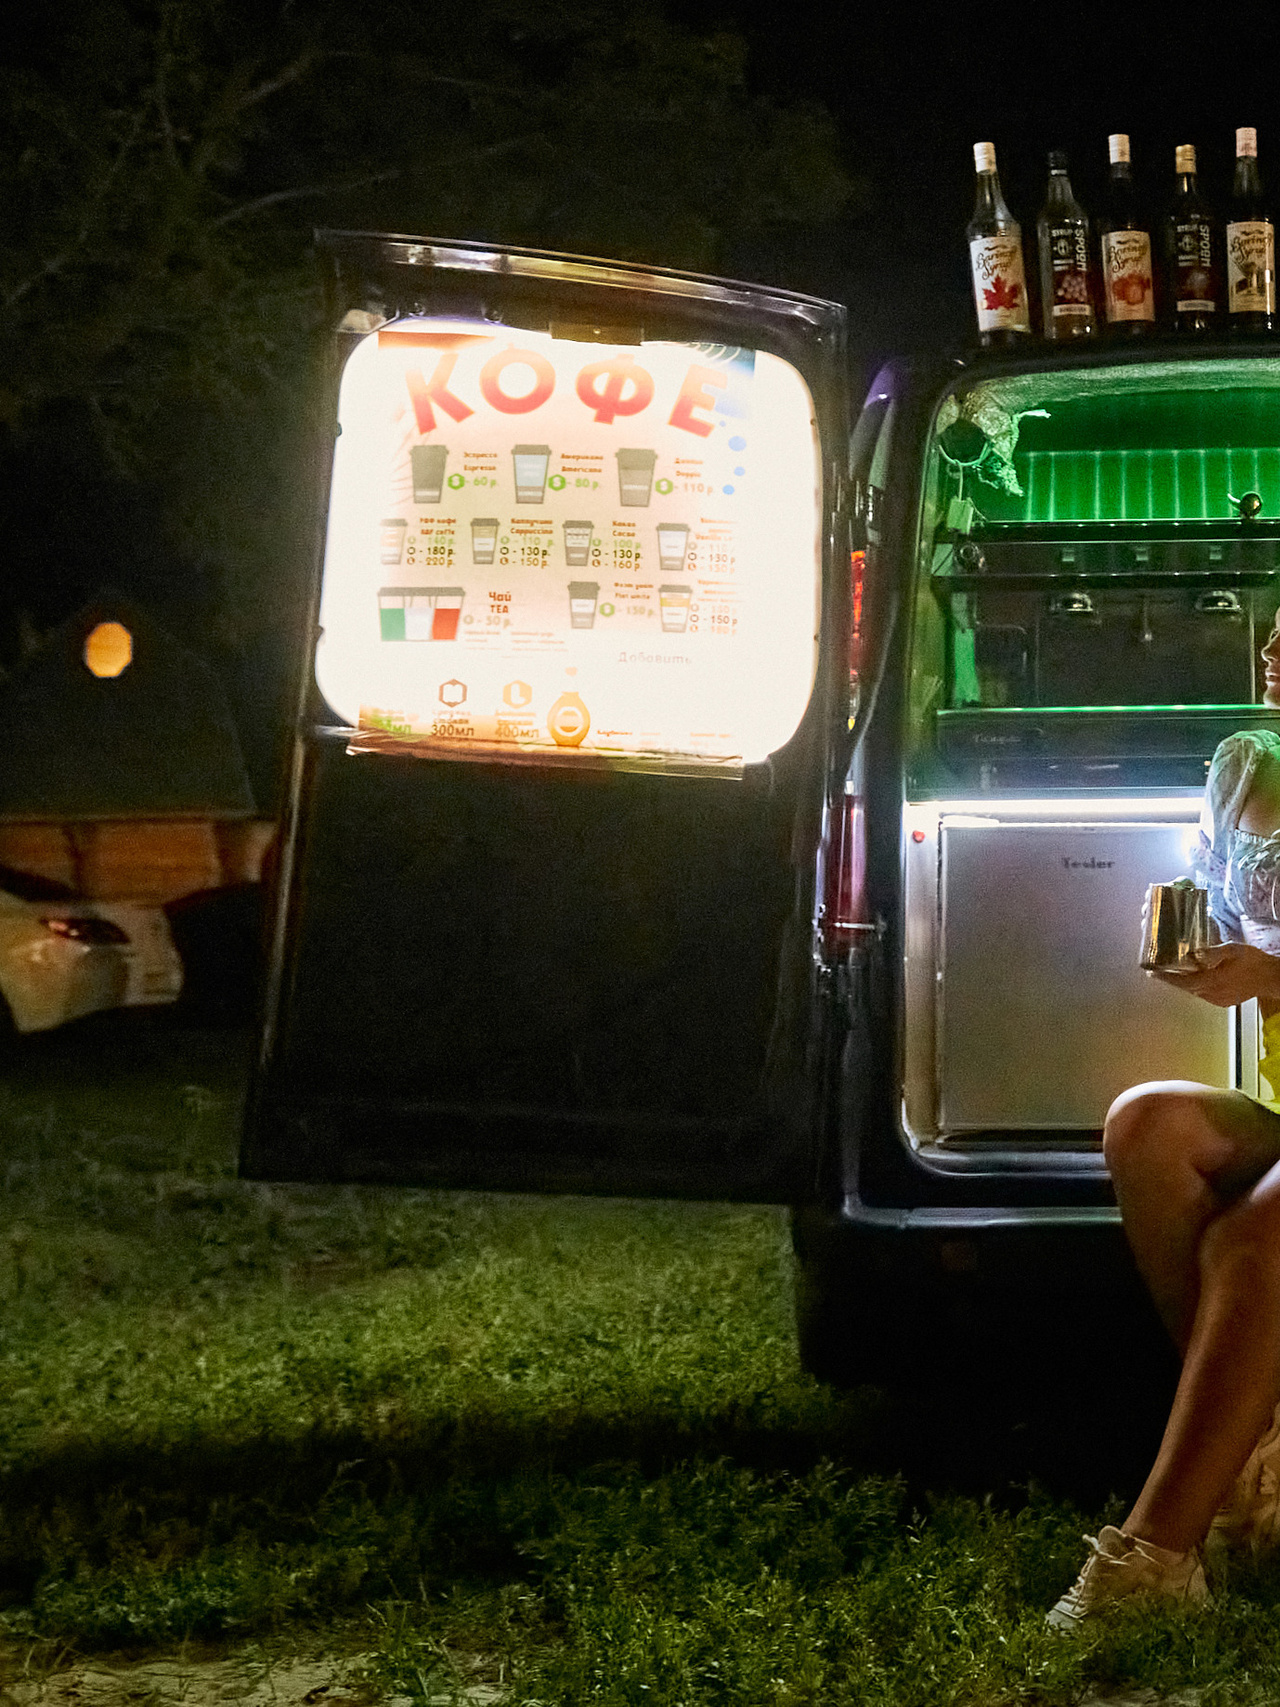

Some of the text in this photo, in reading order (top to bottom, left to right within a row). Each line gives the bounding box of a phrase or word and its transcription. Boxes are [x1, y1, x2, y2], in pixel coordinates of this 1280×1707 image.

[404, 343, 729, 438] КОФЕ
[426, 546, 446, 555] 180
[520, 547, 540, 556] 130
[612, 549, 633, 559] 130
[425, 557, 446, 566] 220
[520, 557, 540, 566] 150
[612, 560, 633, 569] 160
[488, 590, 512, 602] Чай
[489, 604, 510, 614] TEA
[710, 614, 730, 624] 150
[431, 724, 475, 738] 300мл
[495, 726, 540, 739] 400мл
